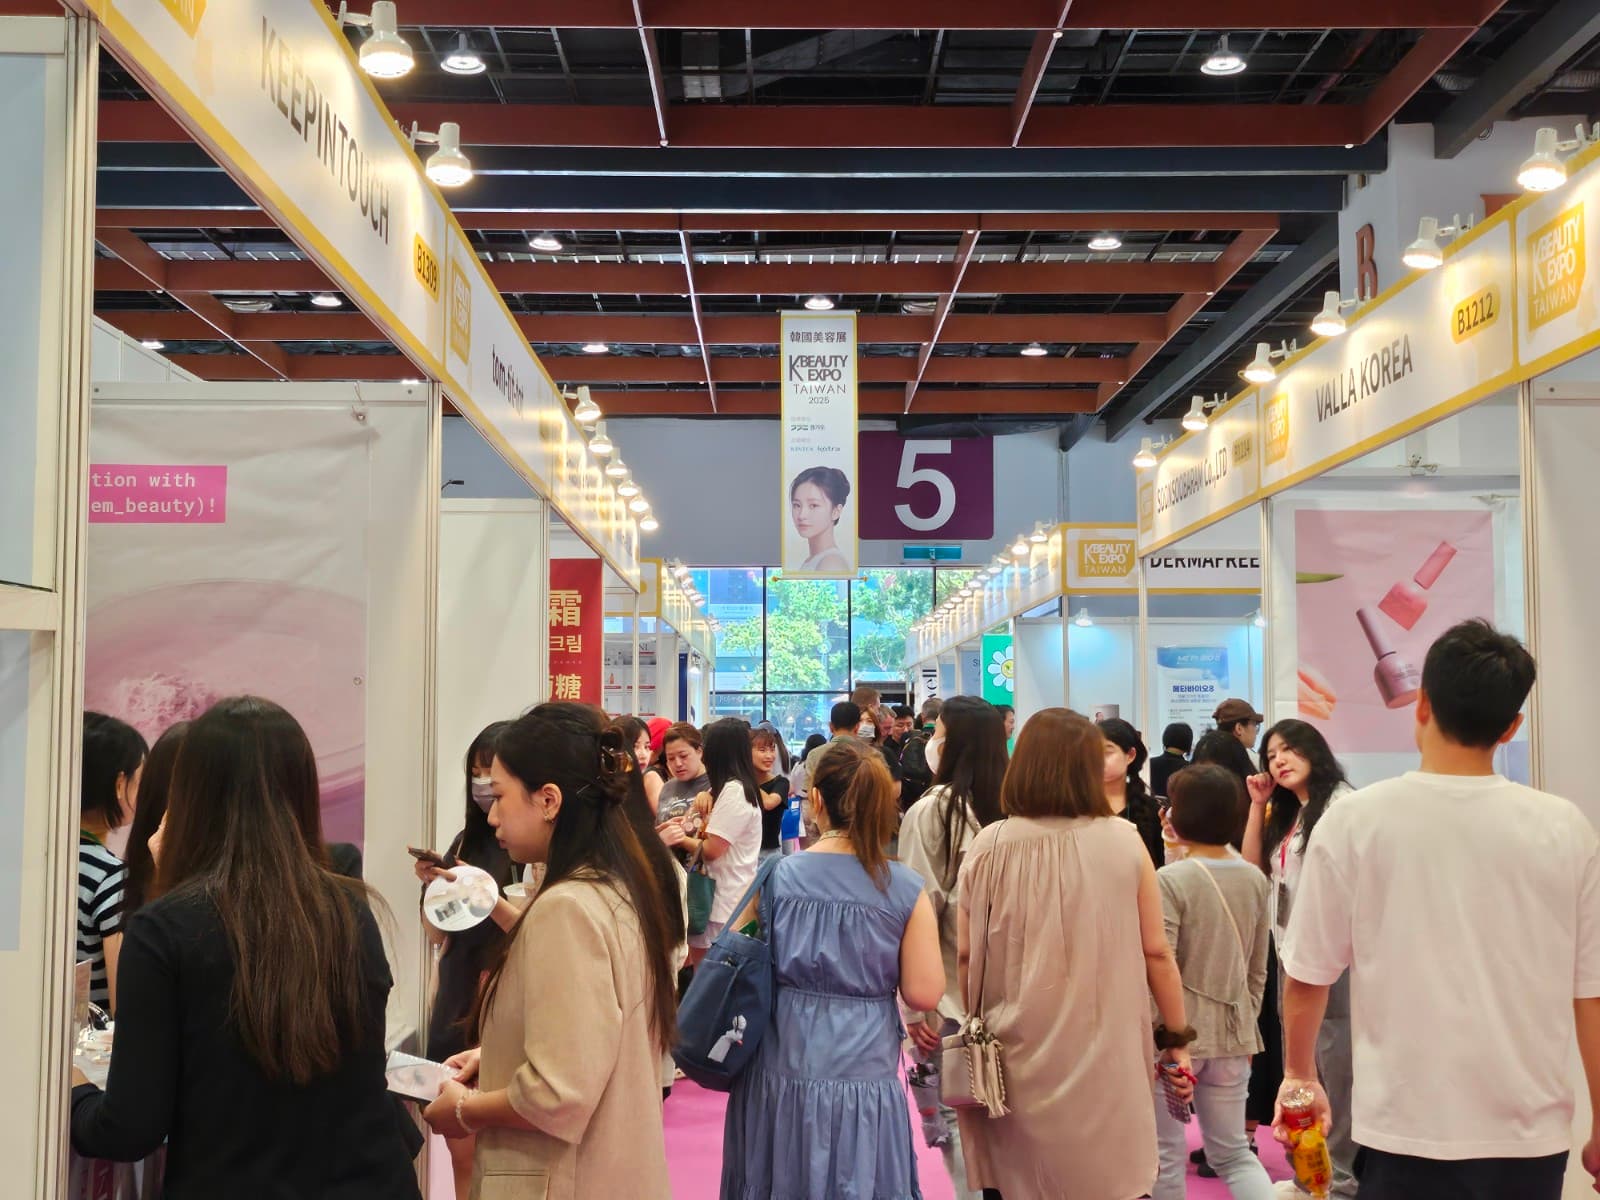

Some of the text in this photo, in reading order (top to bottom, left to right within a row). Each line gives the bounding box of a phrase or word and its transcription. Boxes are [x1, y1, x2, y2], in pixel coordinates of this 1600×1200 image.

[261, 15, 389, 245] KEEPINTOUCH
[417, 244, 437, 292] B1309
[1547, 248, 1576, 285] EXPO
[1457, 292, 1495, 336] B1212
[1533, 285, 1577, 320] TAIWAN
[790, 331, 847, 343] 韓國美容展
[808, 369, 842, 381] EXPO
[1315, 333, 1413, 422] VALLA KOREA
[793, 384, 846, 394] TAIWAN
[808, 396, 830, 404] 2025
[91, 472, 196, 488] tion with
[894, 439, 956, 531] 5
[91, 497, 216, 517] em_beauty)!
[1085, 565, 1127, 575] TAIWAN
[1099, 554, 1127, 564] EXPO
[549, 590, 582, 627] 霜
[549, 673, 582, 700] 糖
